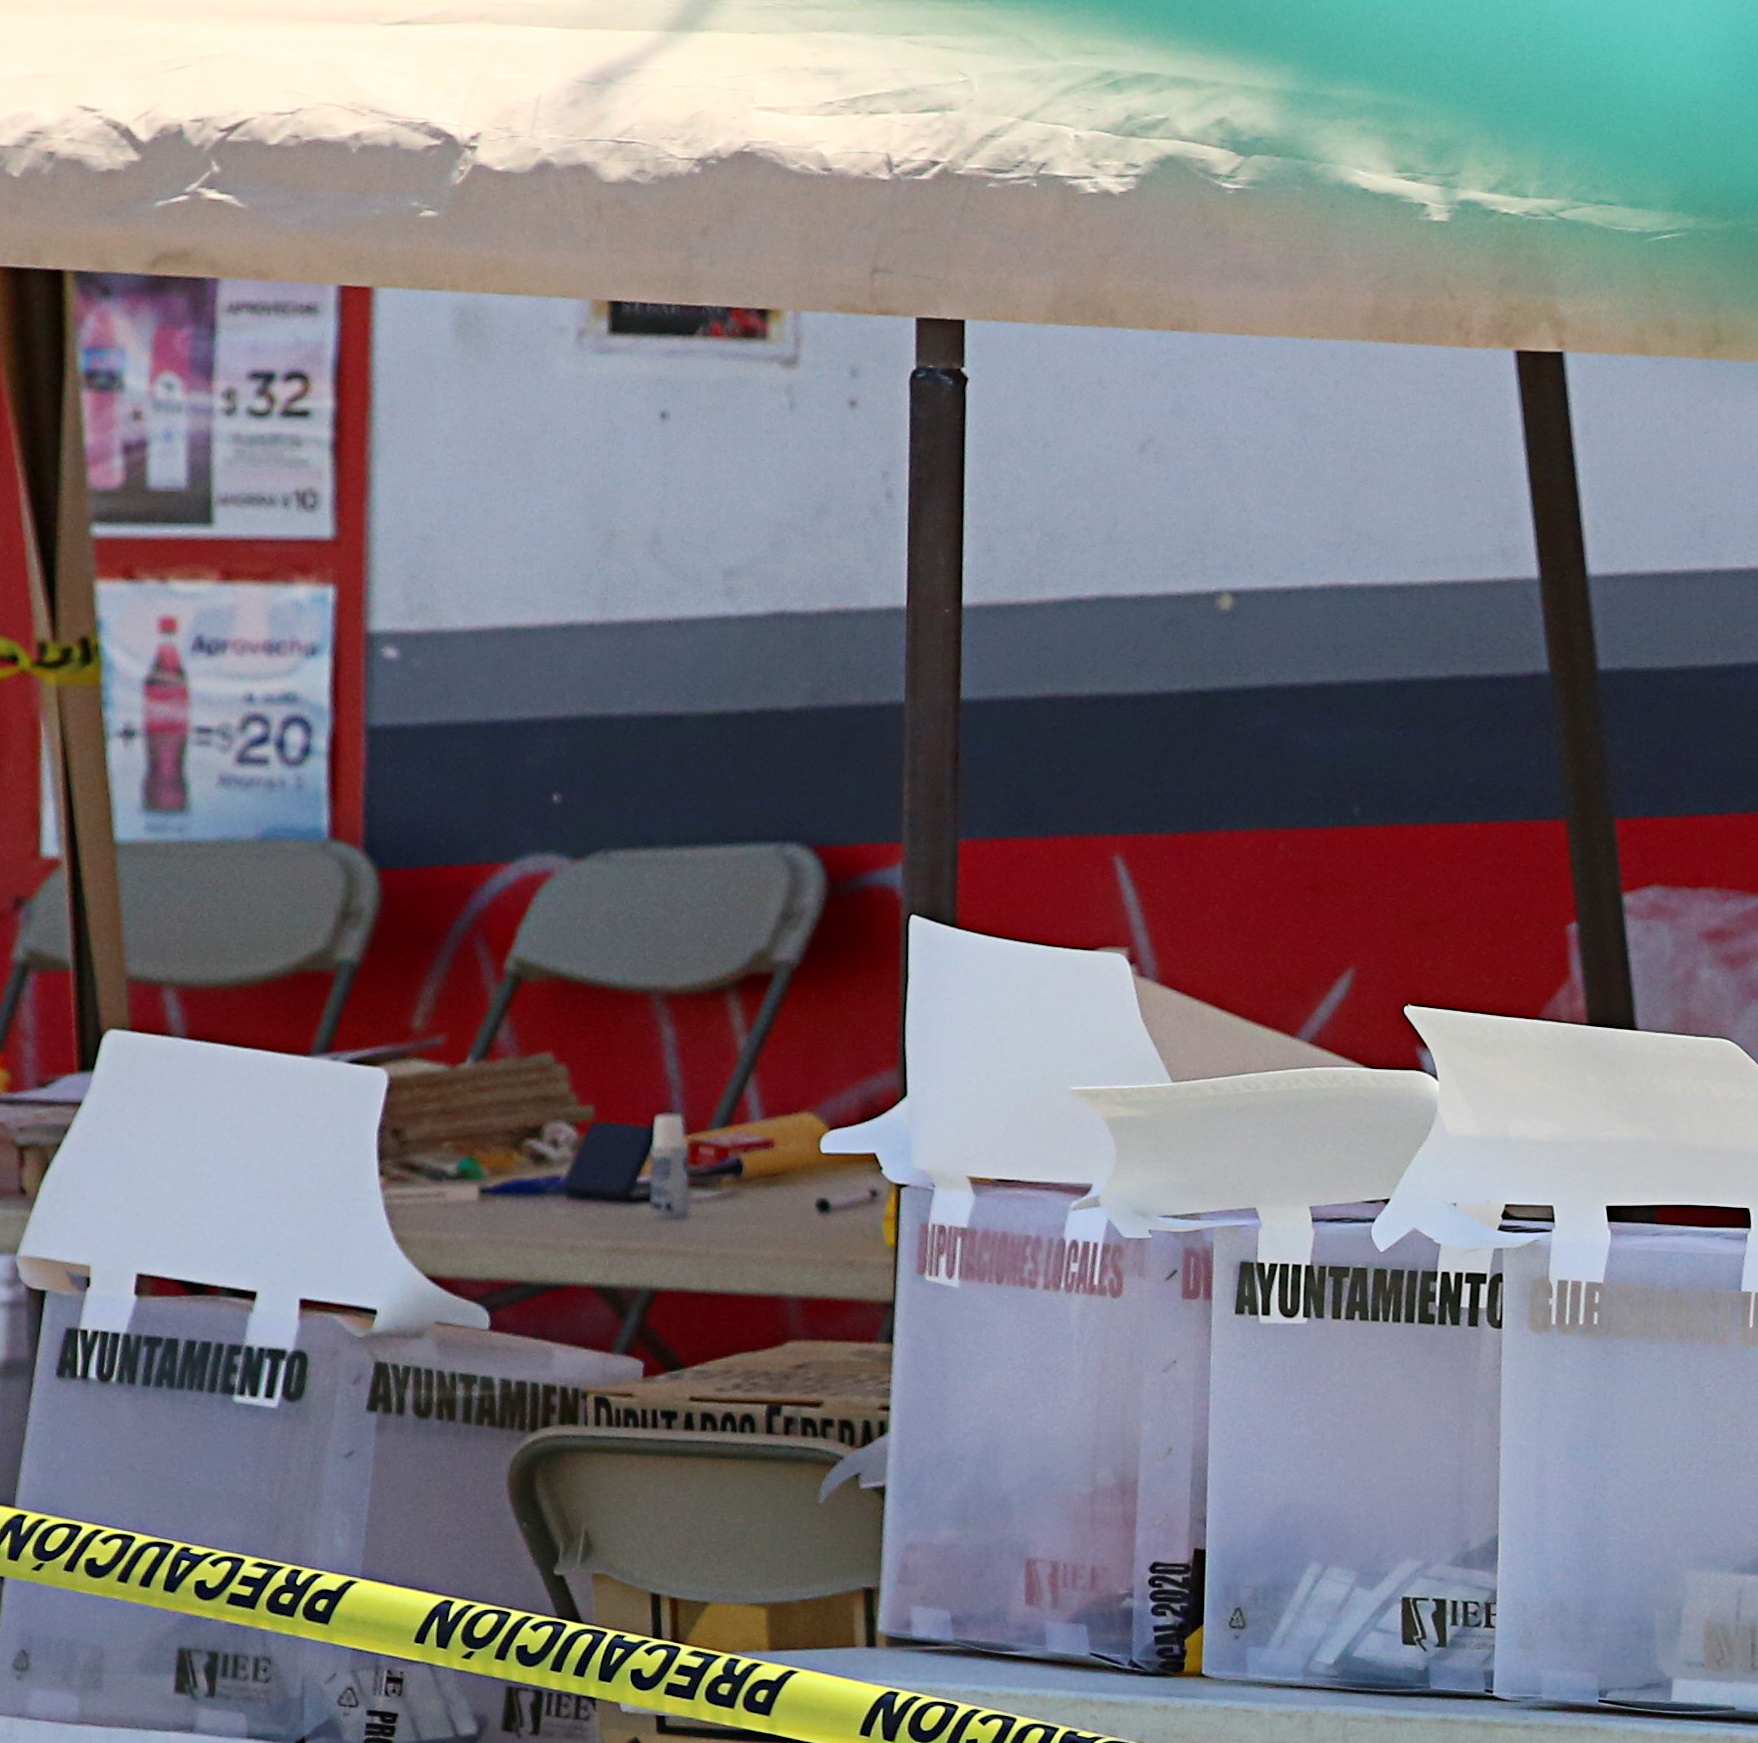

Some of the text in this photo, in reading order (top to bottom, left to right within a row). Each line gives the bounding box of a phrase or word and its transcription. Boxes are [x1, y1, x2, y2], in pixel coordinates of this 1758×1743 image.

[245, 370, 312, 418] 32
[56, 1327, 309, 1403] AYUNTAMIENTO
[0, 1513, 358, 1625] PRECAUCIÓN
[1147, 1560, 1192, 1619] 2020
[220, 1653, 273, 1684] IEE
[414, 1600, 799, 1717] PRECAUCIÓN
